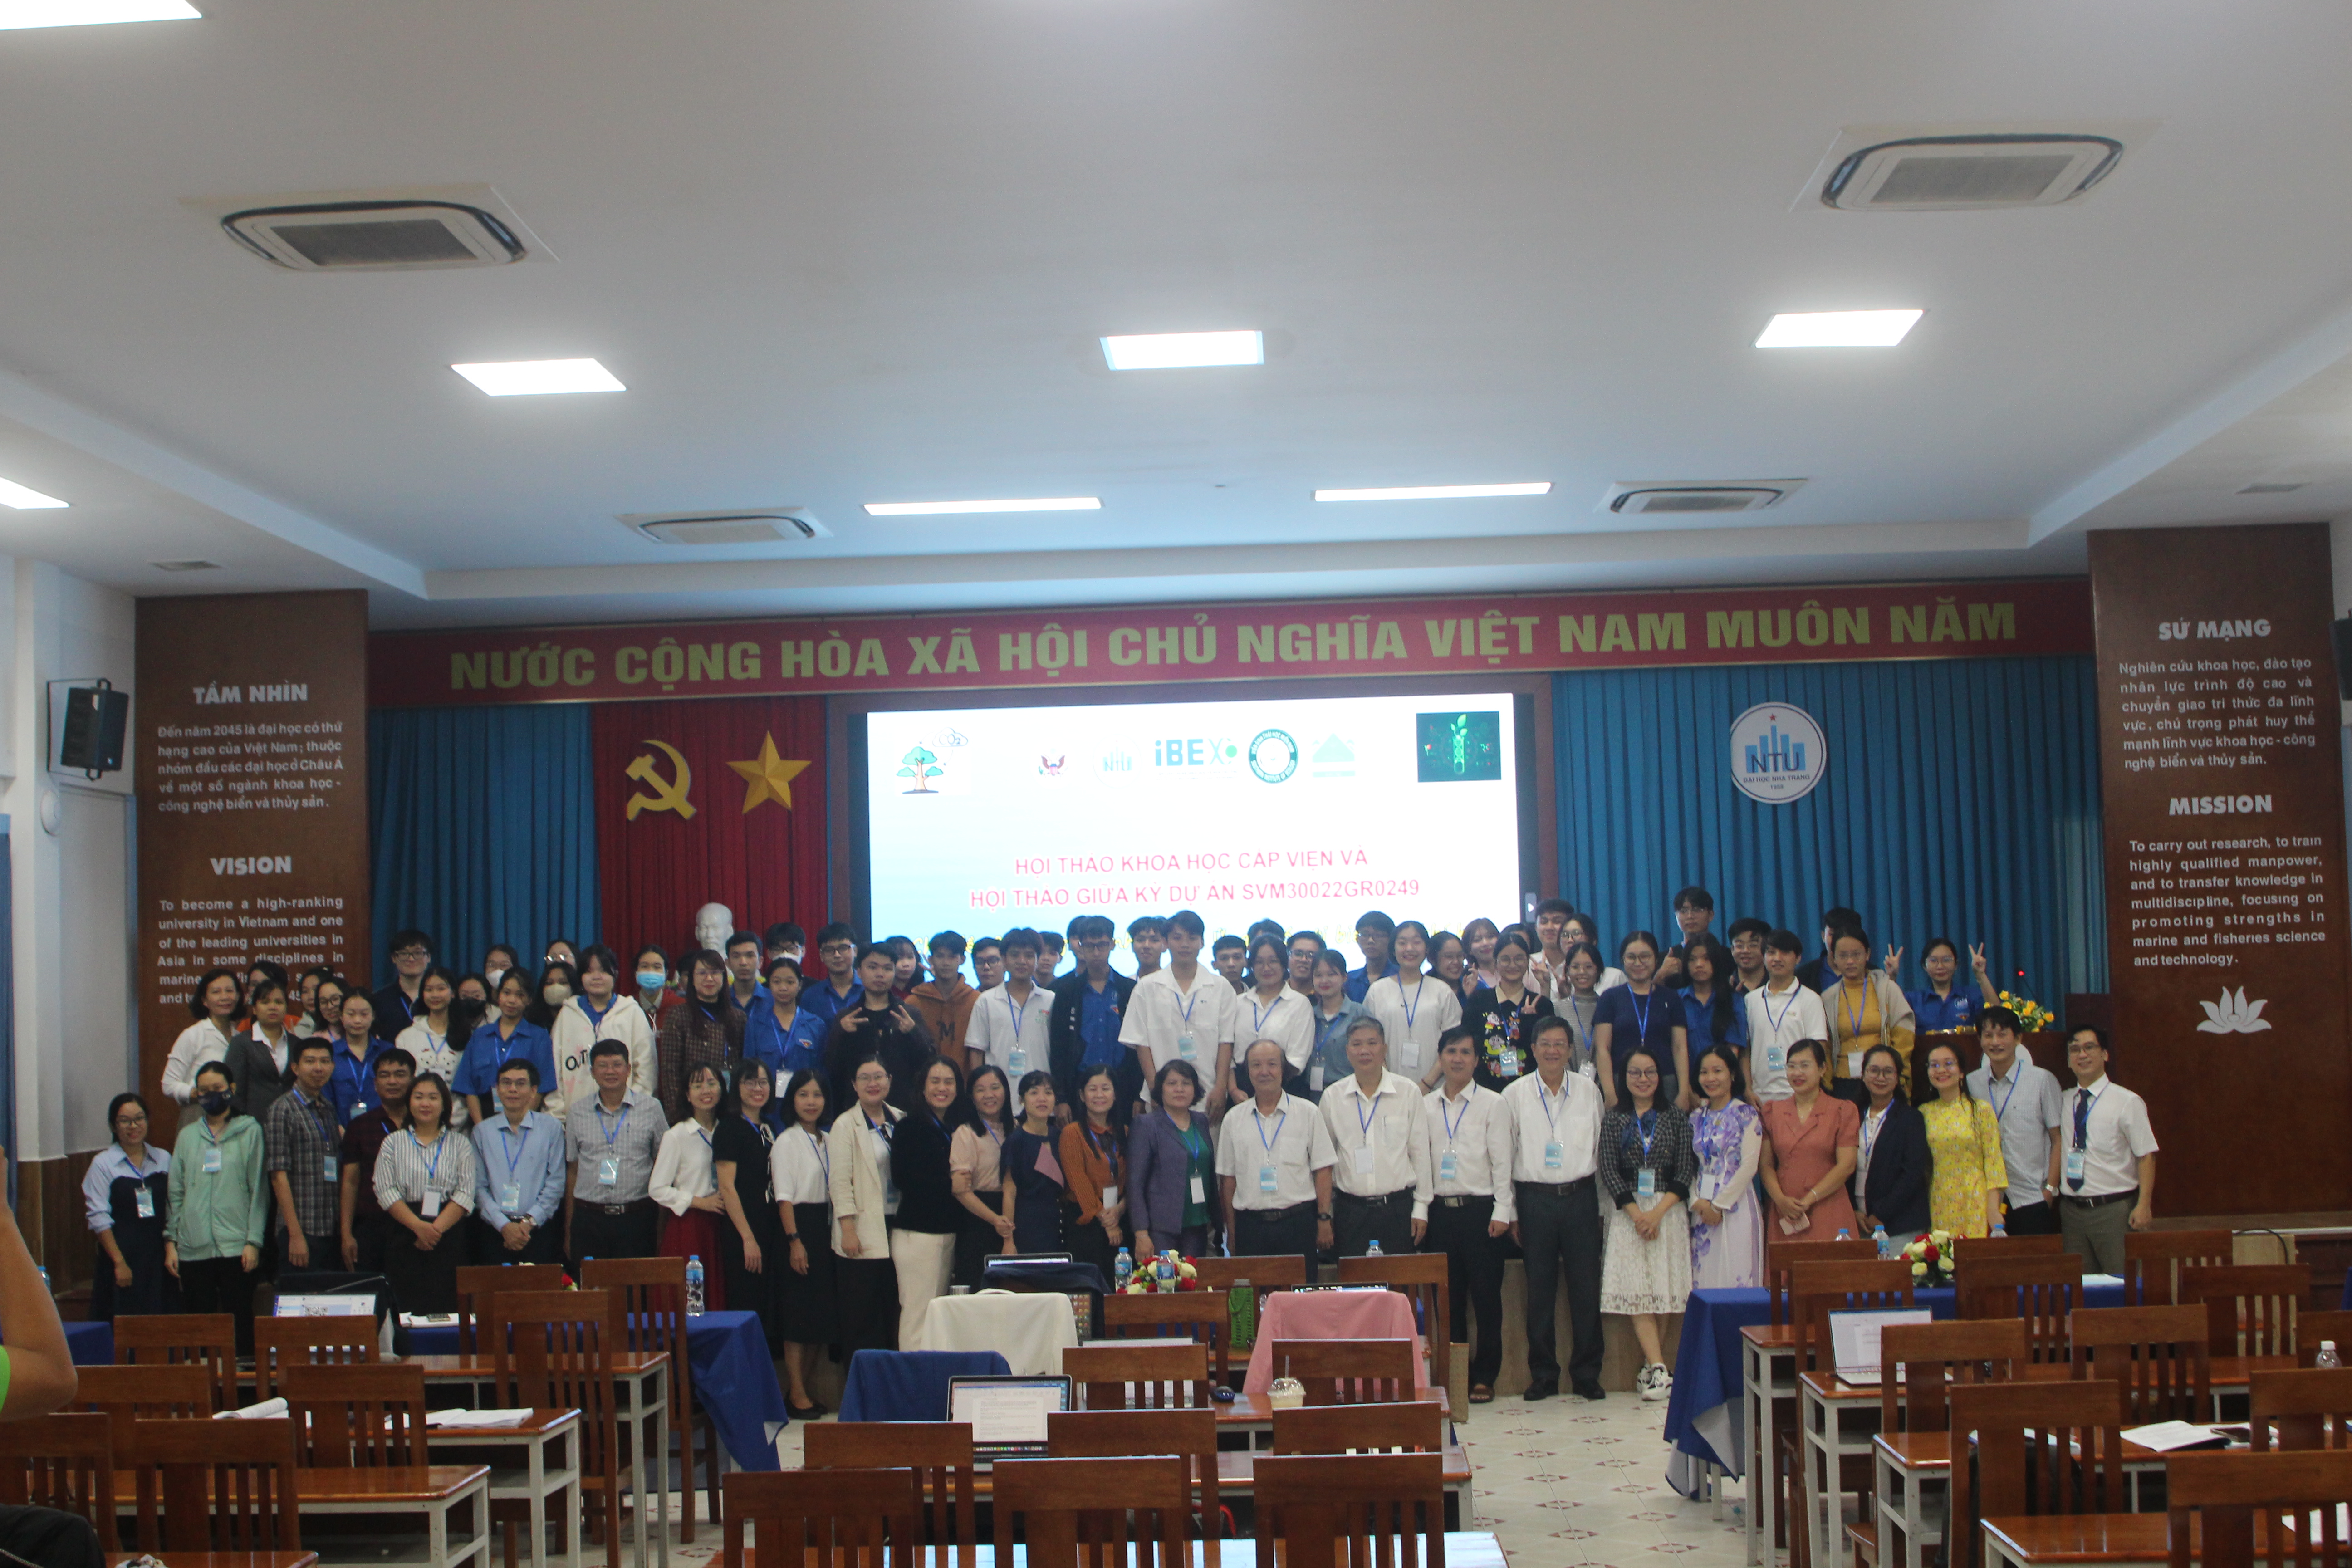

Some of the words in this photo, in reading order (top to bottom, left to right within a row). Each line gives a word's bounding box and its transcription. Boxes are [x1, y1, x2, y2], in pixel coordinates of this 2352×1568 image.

[452, 642, 596, 688] NƯỚC
[616, 638, 761, 691] CỘNG
[782, 631, 890, 677] HÒA
[908, 628, 980, 674] XÃ
[1000, 623, 1088, 677] HỘI
[1109, 614, 1216, 666] CHỦ
[1238, 615, 1408, 662] NGHĨA
[1424, 610, 1539, 664] VIỆT
[1559, 613, 1685, 653] NAM
[1706, 601, 1870, 648] MUÔN
[1890, 597, 2014, 643] NĂM
[2198, 660, 2228, 671] khoa
[2263, 680, 2286, 688] cao
[2178, 700, 2205, 713] giao
[2212, 698, 2225, 709] tri
[2266, 716, 2288, 729] huy
[214, 725, 242, 736] 2045
[193, 746, 215, 755] cao
[271, 742, 303, 753] Nam;
[2216, 736, 2247, 746] khoa
[1751, 751, 1800, 772] NTU
[274, 779, 304, 789] khoa
[2169, 795, 2272, 815] MISSION
[2130, 841, 2145, 852] To
[2149, 842, 2182, 853] carry
[2187, 839, 2207, 850] out
[2212, 837, 2270, 849] research,
[2276, 837, 2288, 847] to
[2293, 837, 2321, 846] train
[211, 856, 291, 875] VISION
[1122, 854, 1181, 872] KHOA
[1187, 853, 1230, 874] HỌC
[1340, 845, 1368, 866] VÀ
[2130, 859, 2171, 873] highly
[2181, 857, 2239, 872] qualified
[2248, 857, 2322, 868] manpower,
[2131, 878, 2155, 890] and
[2161, 879, 2173, 889] to
[2179, 876, 2230, 888] transfer
[2236, 874, 2305, 887] knowledge
[2312, 873, 2323, 883] in
[1076, 884, 1129, 905] GIỮA
[1135, 882, 1161, 902] KỲ
[1169, 885, 1200, 906] DỰ
[1206, 881, 1235, 901] ÁN
[1242, 879, 1419, 900] SVM30022GR0249
[160, 900, 174, 911] To
[182, 900, 233, 910] become
[242, 900, 249, 909] a
[257, 896, 343, 911] high-ranking
[2132, 896, 2233, 909] multidiscipline,
[2242, 894, 2298, 906] focusing
[2308, 894, 2323, 903] on
[159, 917, 219, 931] university
[224, 917, 235, 928] in
[239, 916, 288, 927] Vietnam
[293, 916, 315, 926] and
[320, 917, 343, 926] one
[2132, 915, 2213, 930] promoting
[2225, 912, 2300, 926] strengths
[2311, 911, 2324, 921] in
[159, 938, 171, 949] of
[176, 938, 196, 948] the
[202, 937, 247, 950] leading
[254, 934, 326, 946] universities
[333, 934, 343, 944] in
[2133, 935, 2177, 946] marine
[2184, 934, 2207, 945] and
[2214, 933, 2269, 944] fisheries
[2276, 931, 2325, 942] science
[157, 956, 185, 966] Asia
[193, 955, 205, 965] in
[213, 956, 246, 965] some
[333, 951, 343, 962] in
[2134, 955, 2158, 966] and
[2161, 953, 2238, 966] technology.
[160, 974, 201, 985] marine
[160, 993, 182, 1004] and
